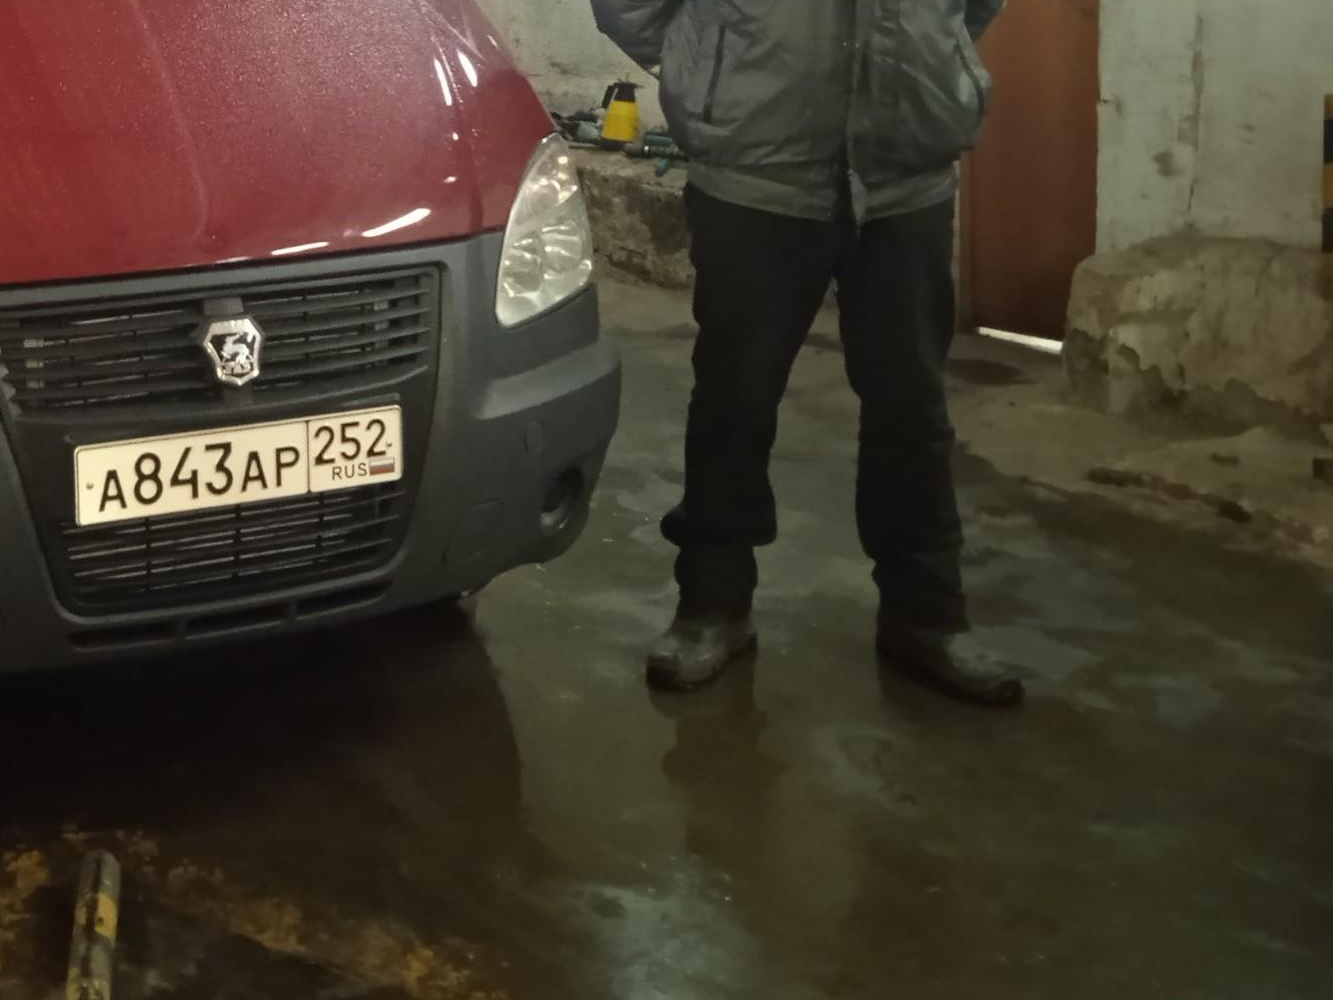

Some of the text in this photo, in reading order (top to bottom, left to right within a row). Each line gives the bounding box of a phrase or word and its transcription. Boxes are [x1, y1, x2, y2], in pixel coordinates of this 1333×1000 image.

[98, 418, 387, 513] А843АР 252
[331, 462, 368, 481] RUS
